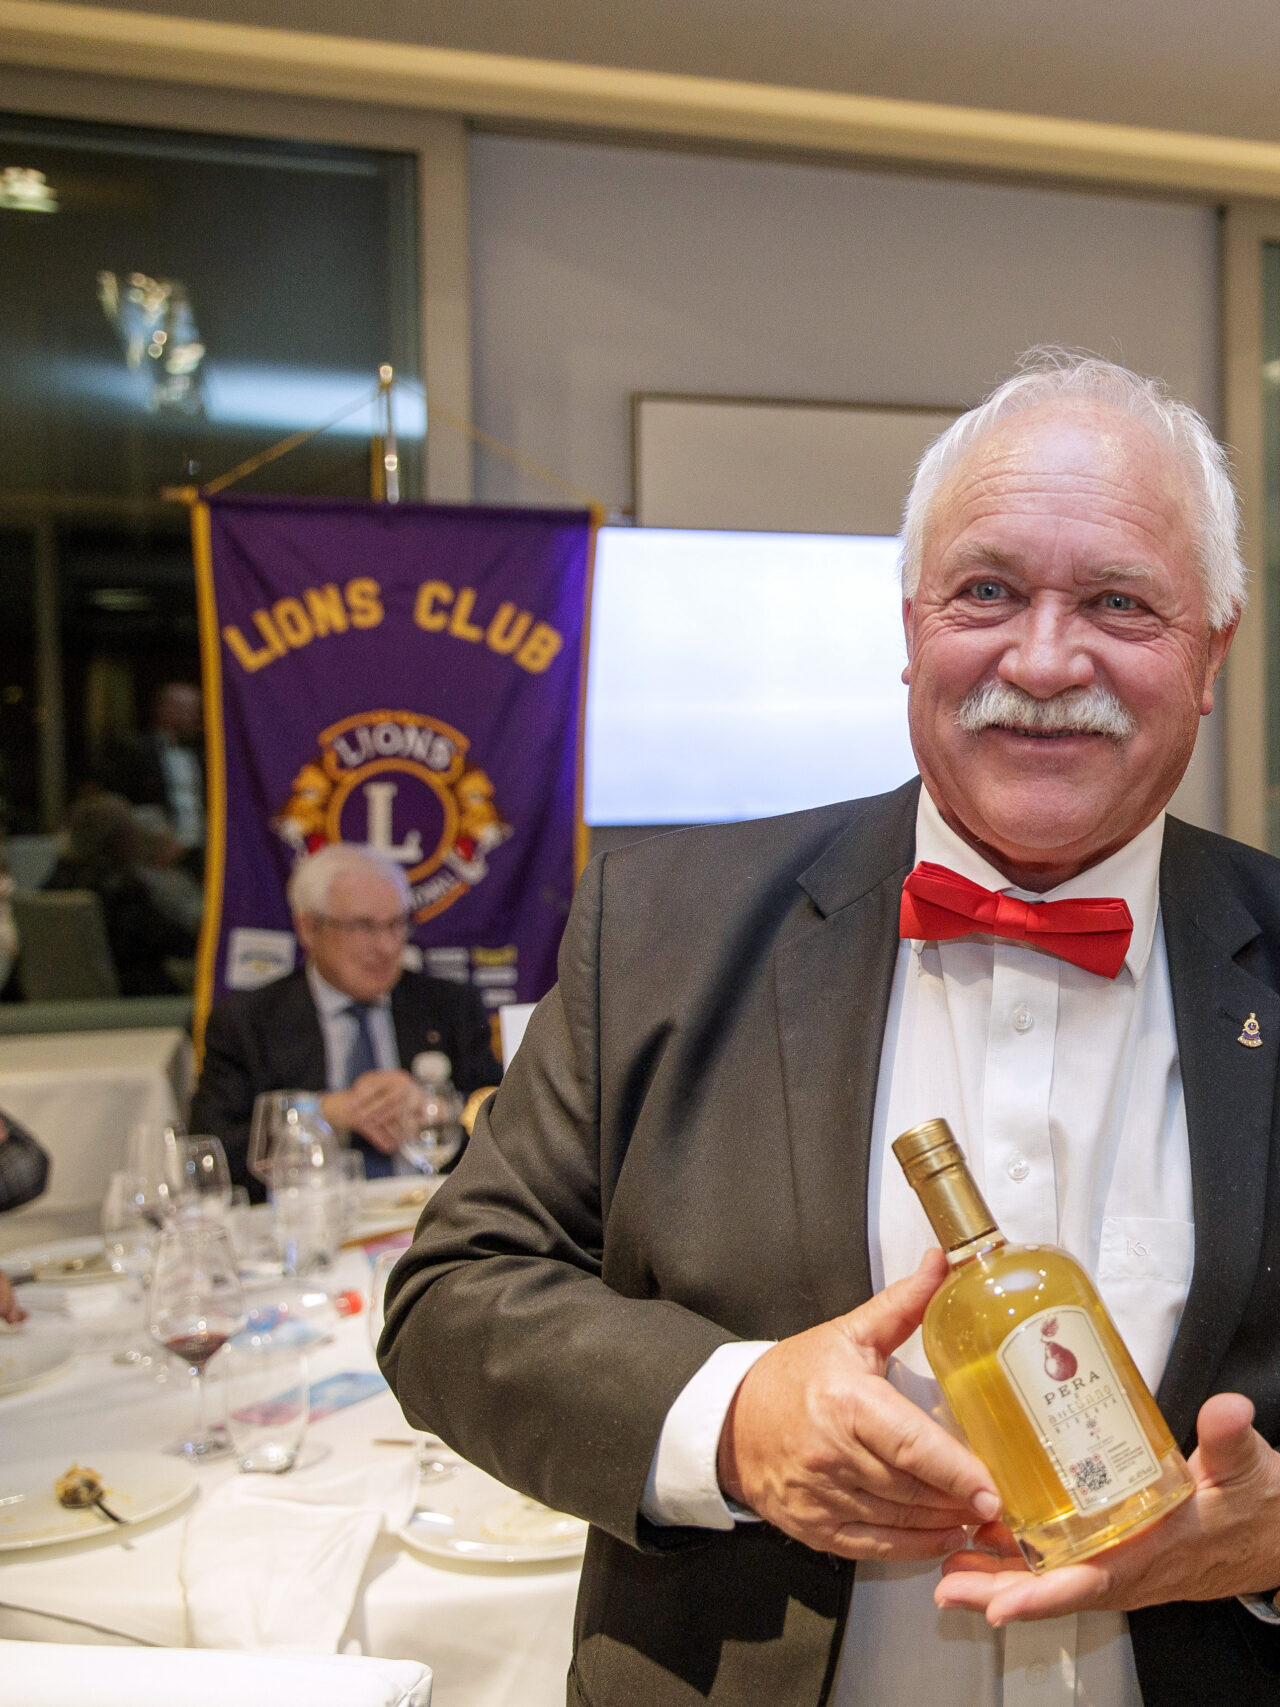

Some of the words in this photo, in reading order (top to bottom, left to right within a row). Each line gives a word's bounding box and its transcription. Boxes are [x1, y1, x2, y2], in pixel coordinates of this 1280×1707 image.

[222, 577, 385, 673] LIONS
[414, 580, 564, 674] CLUB
[333, 722, 456, 770] LIONS
[363, 782, 424, 864] L
[1043, 1370, 1100, 1405] PERA
